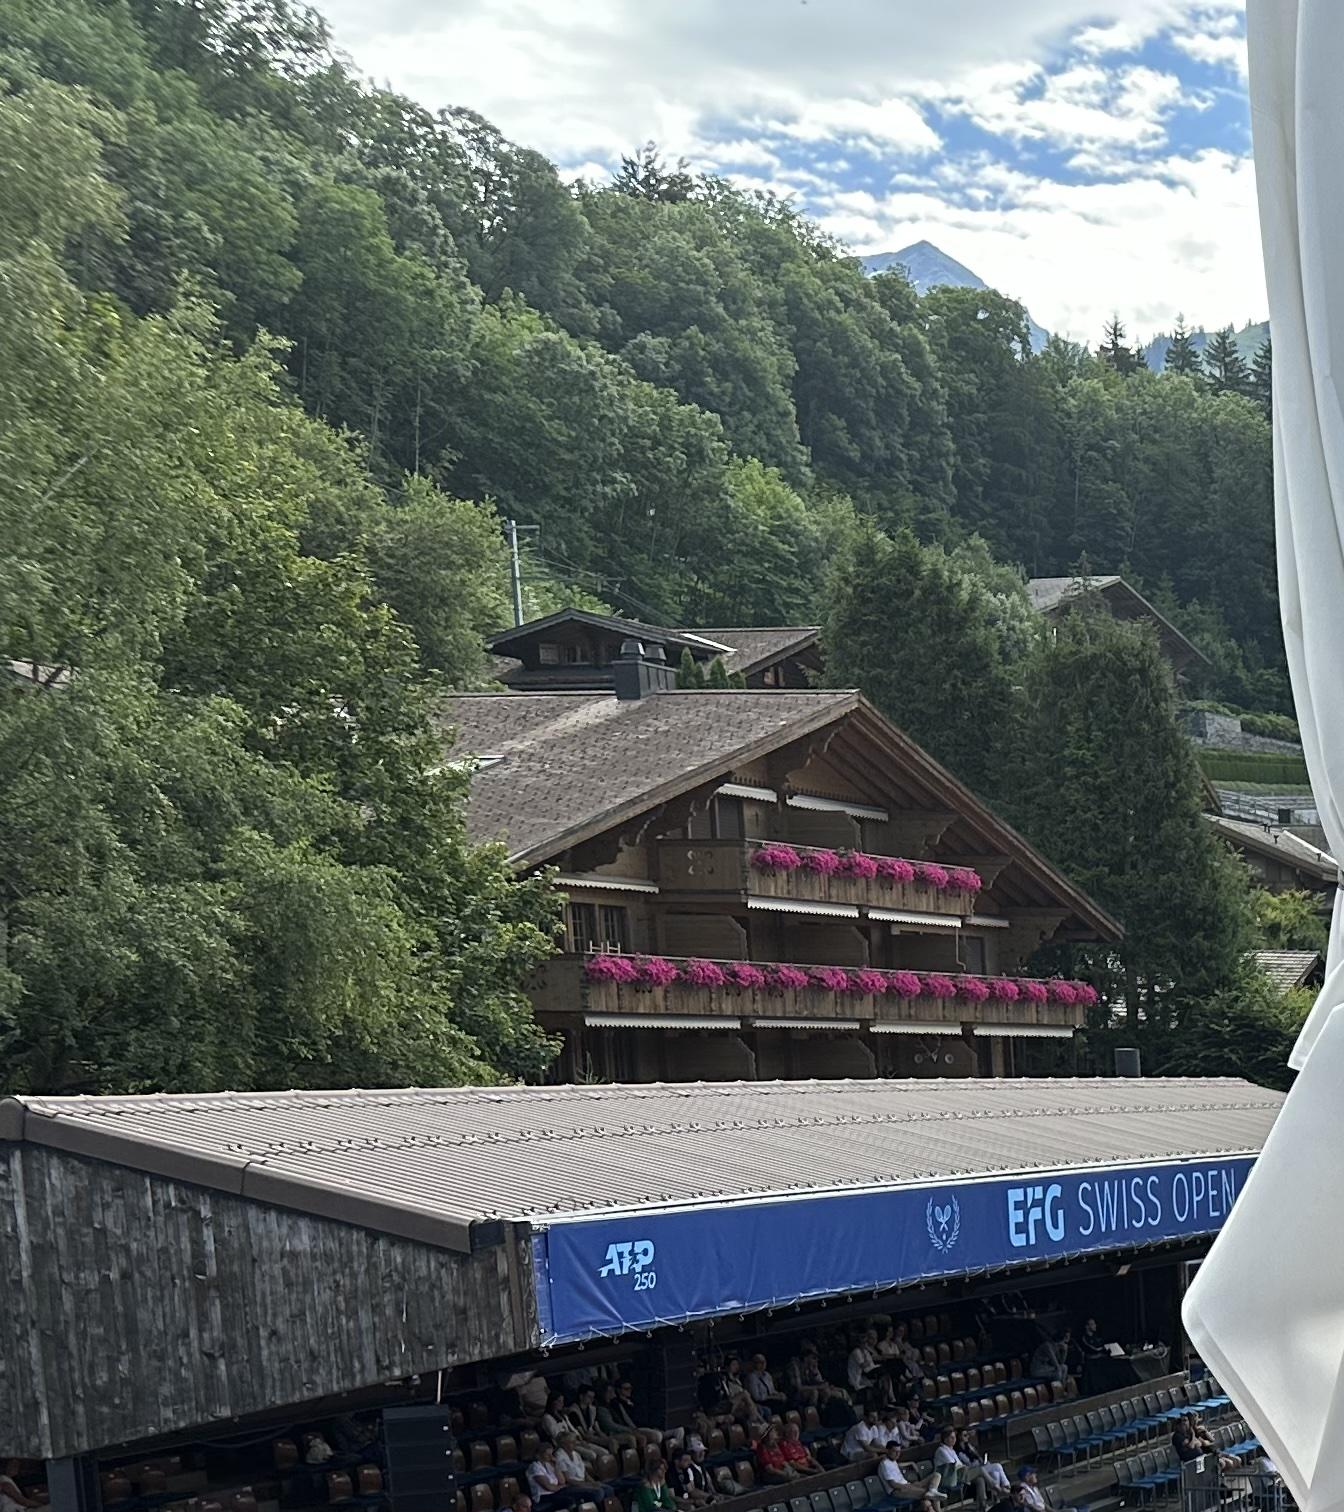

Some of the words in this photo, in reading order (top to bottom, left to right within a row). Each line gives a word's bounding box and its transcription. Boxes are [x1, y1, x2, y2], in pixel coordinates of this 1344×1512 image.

[1007, 1183, 1065, 1248] EFG
[1078, 1175, 1162, 1236] SWISS
[1172, 1167, 1236, 1222] OPEN
[597, 1239, 655, 1278] ATP
[634, 1271, 657, 1291] 250
